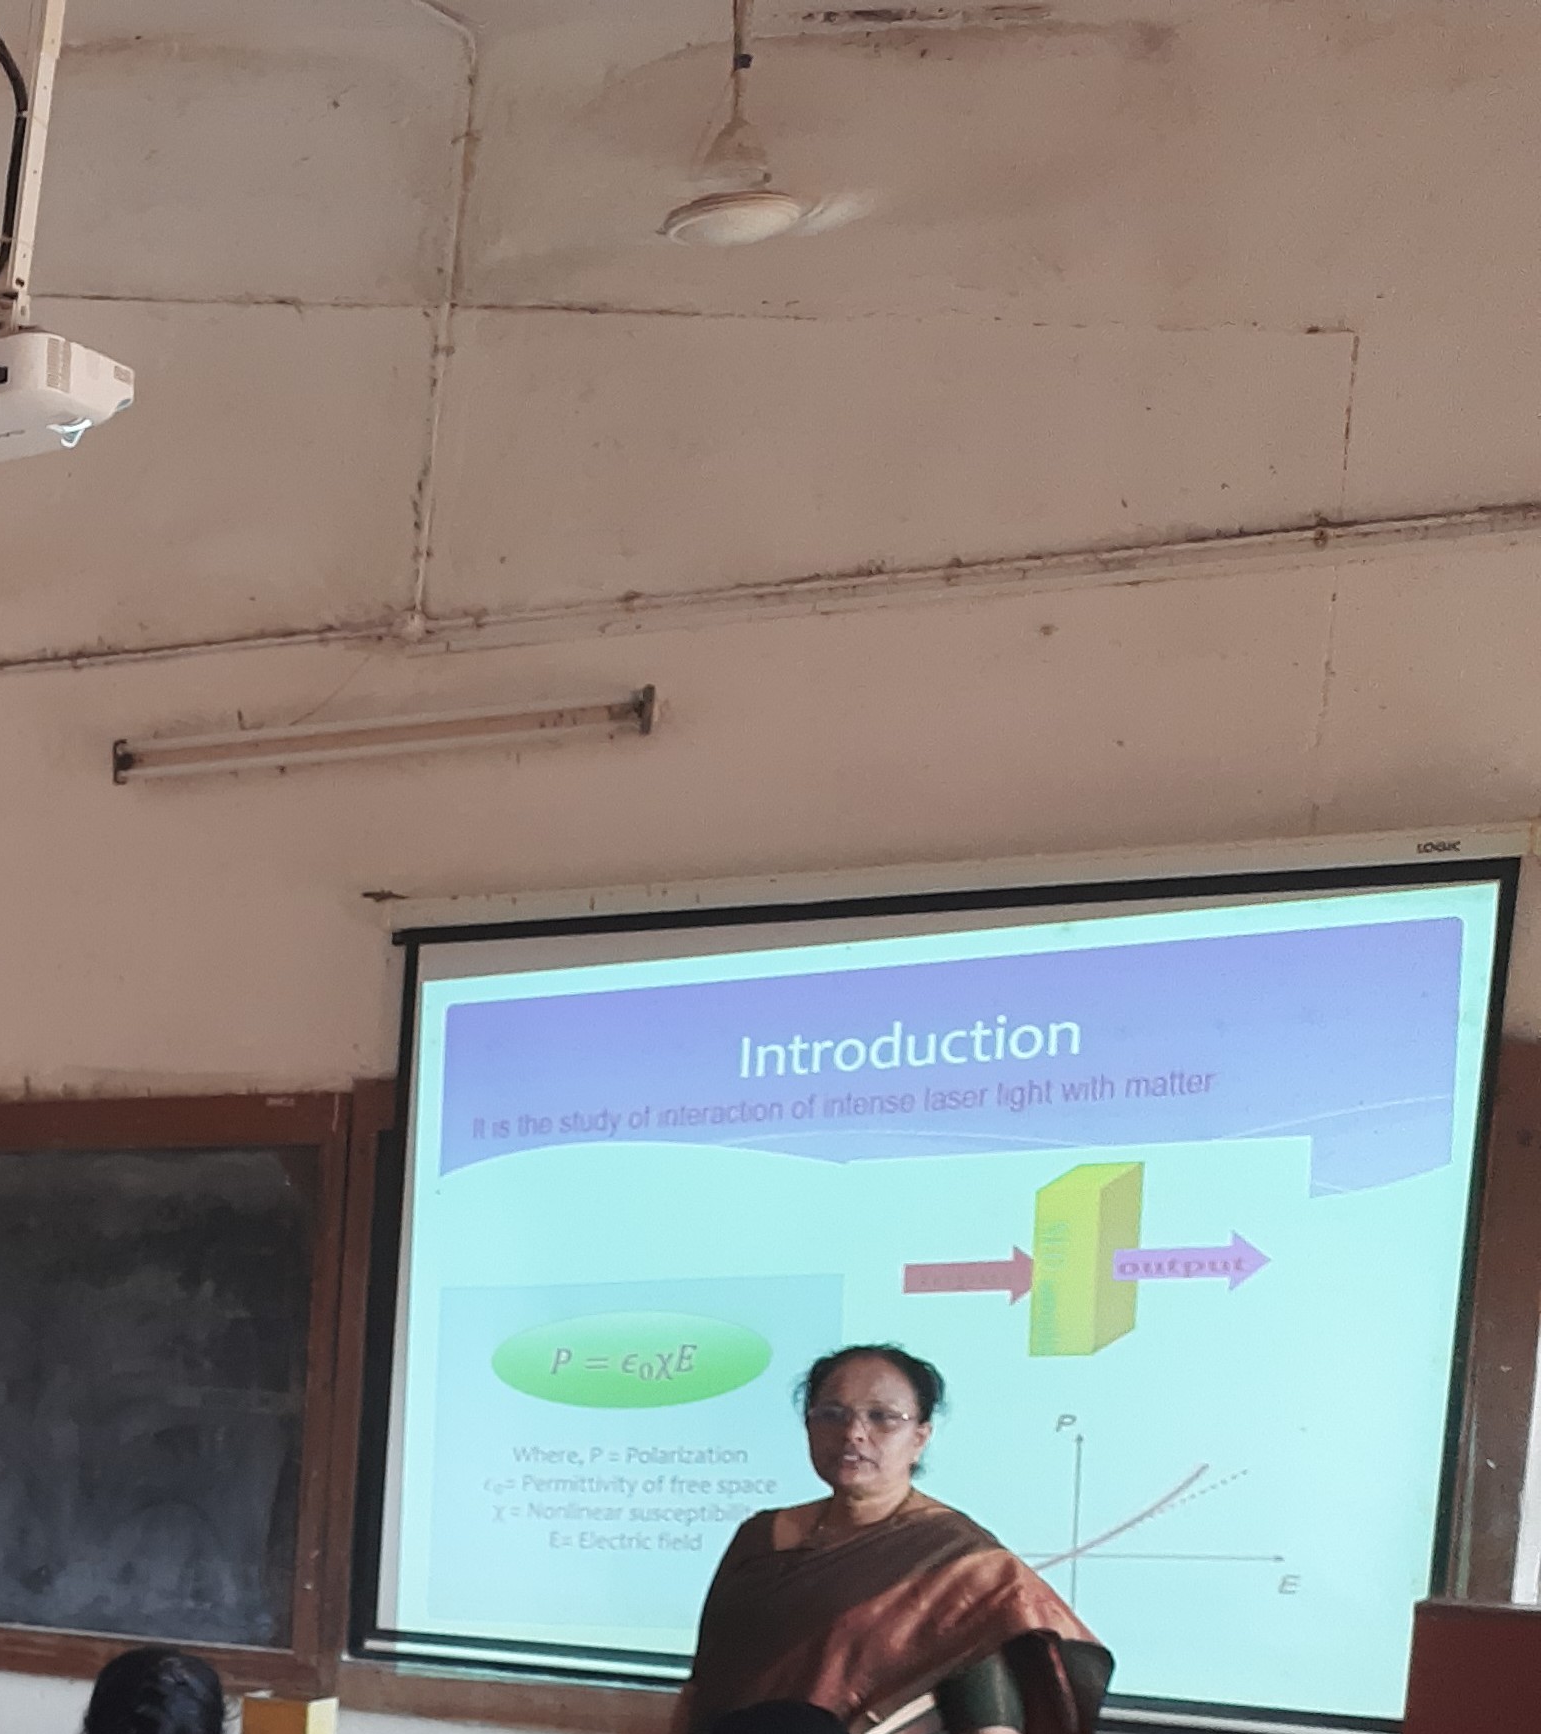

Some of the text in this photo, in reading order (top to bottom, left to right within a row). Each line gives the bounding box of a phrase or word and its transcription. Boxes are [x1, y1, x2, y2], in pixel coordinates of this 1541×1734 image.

[739, 1014, 1081, 1079] Introduction
[472, 1070, 1216, 1139] It is the study of interaction of intense laser light with matter
[1118, 1257, 1248, 1278] output
[550, 1347, 573, 1375] P
[1056, 1413, 1077, 1432] P
[513, 1446, 585, 1467] Where,
[590, 1447, 604, 1464] P
[625, 1446, 749, 1465] Polarization
[522, 1474, 635, 1498] Permittivity
[642, 1474, 665, 1494] of
[670, 1474, 712, 1494] free
[717, 1478, 778, 1498] space
[526, 1502, 623, 1521] Nonlinear
[579, 1531, 651, 1550] Electric
[657, 1531, 703, 1551] field
